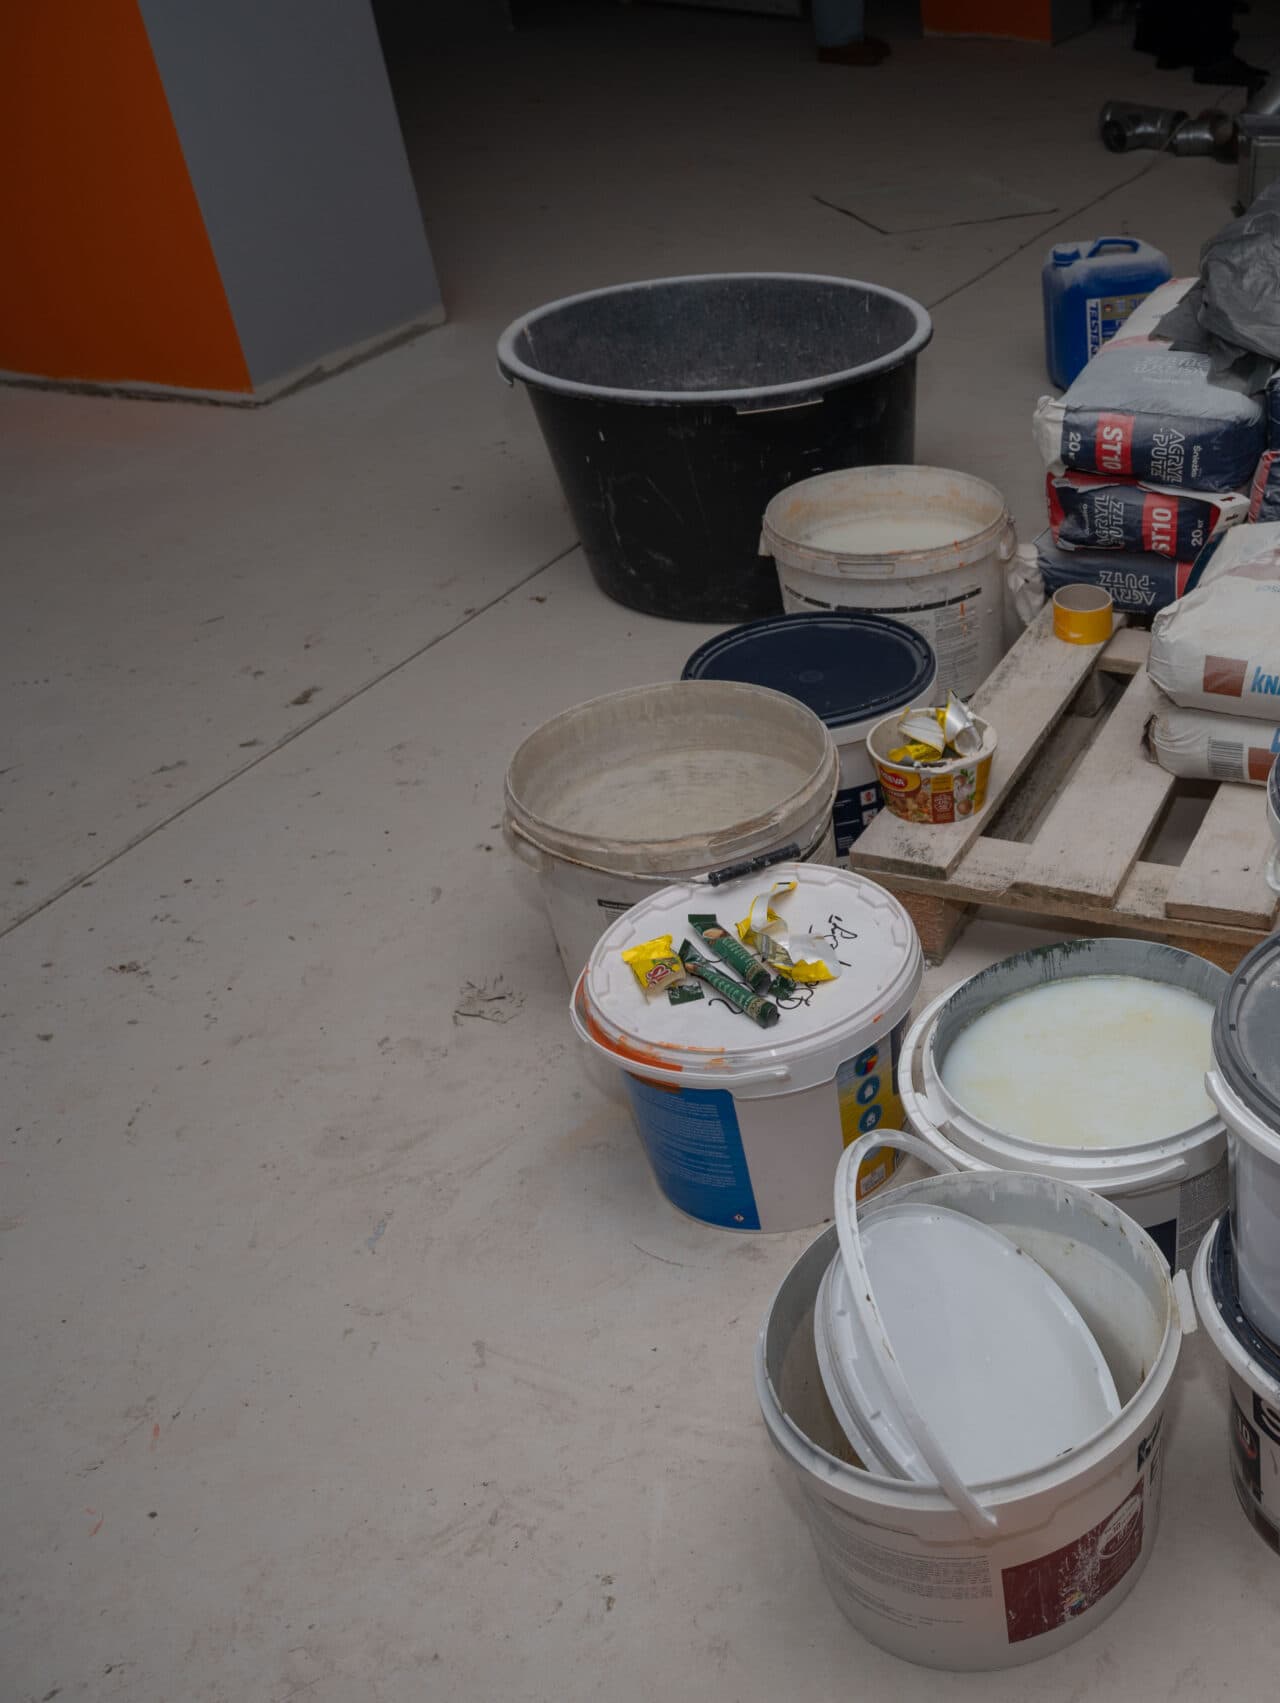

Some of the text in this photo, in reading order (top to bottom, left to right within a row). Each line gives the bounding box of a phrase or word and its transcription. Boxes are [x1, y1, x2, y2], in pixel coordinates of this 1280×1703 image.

[1089, 302, 1099, 357] REISEL
[1069, 432, 1082, 452] 20
[1101, 426, 1123, 470] ST10
[1152, 507, 1171, 552] ST10
[1191, 530, 1204, 547] 20
